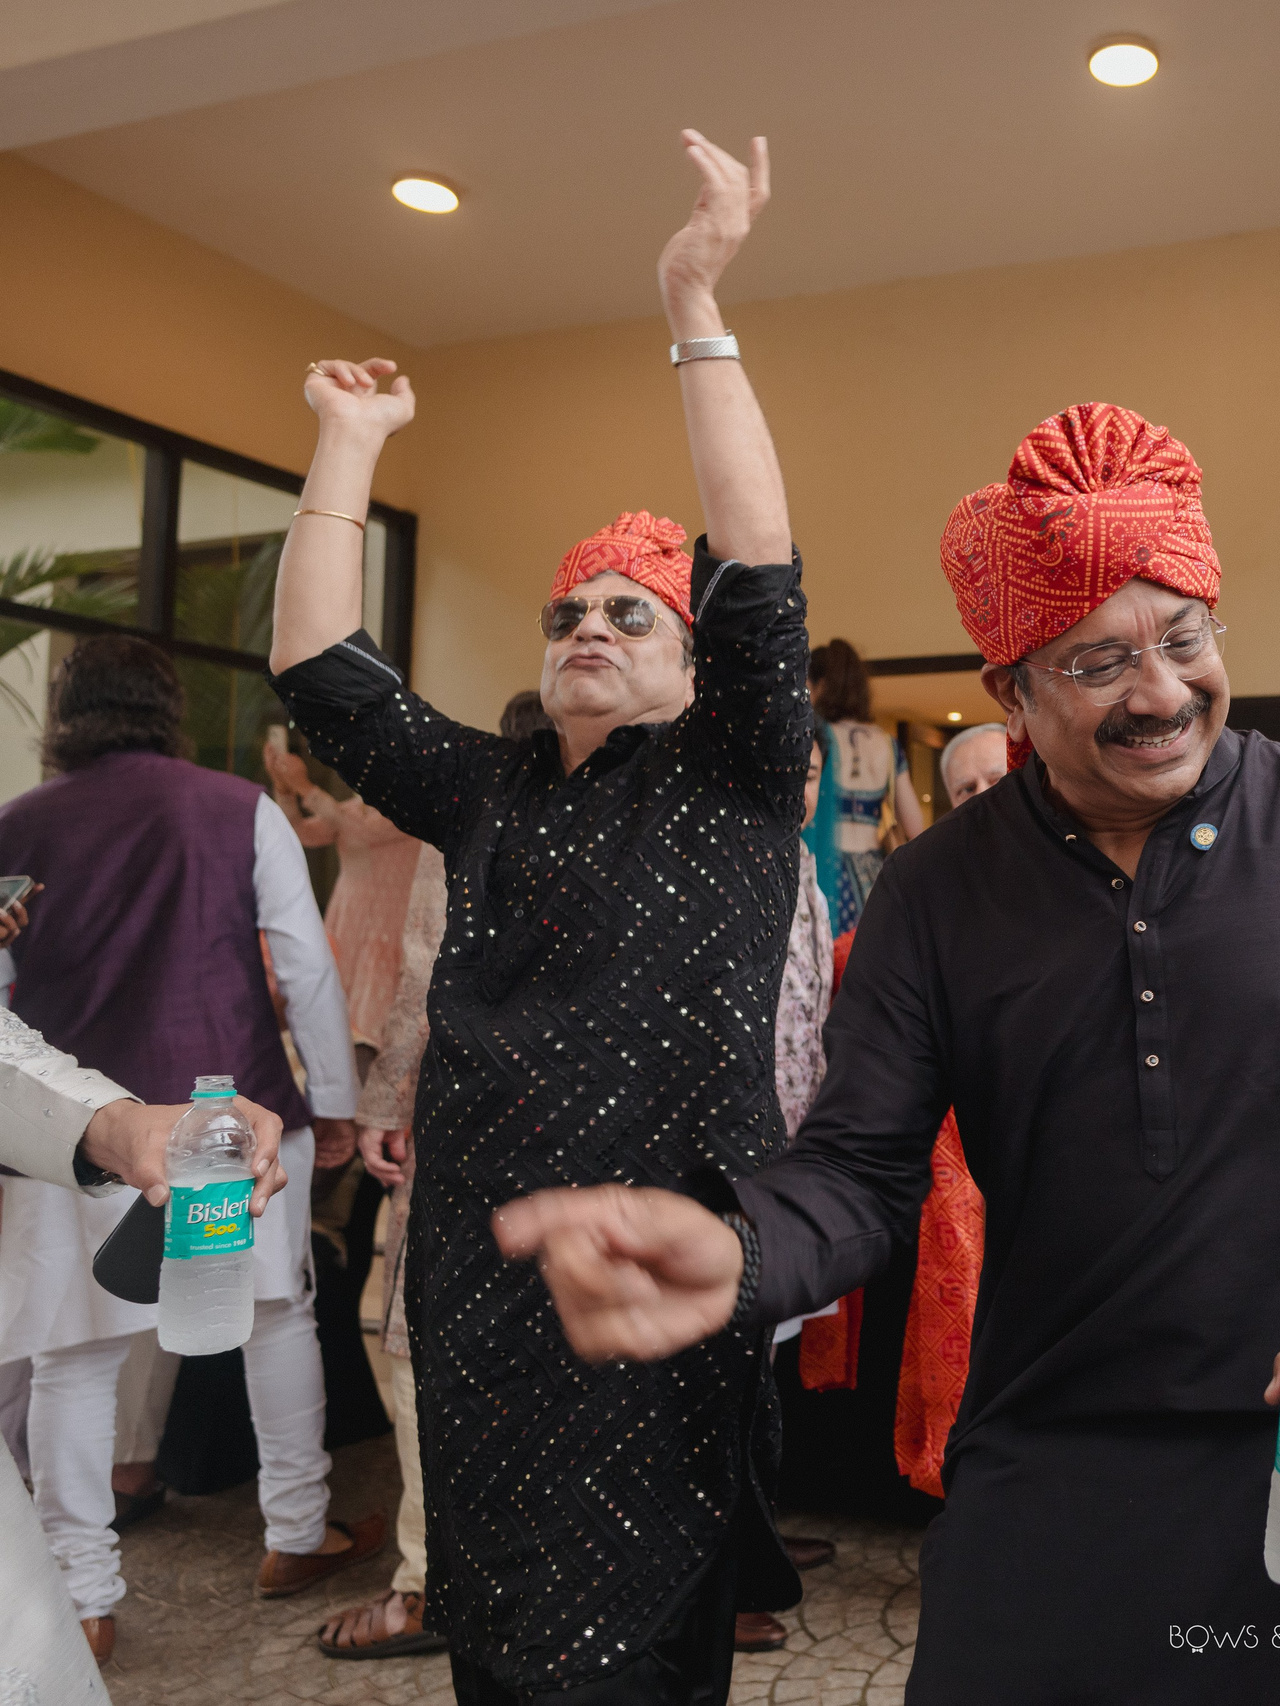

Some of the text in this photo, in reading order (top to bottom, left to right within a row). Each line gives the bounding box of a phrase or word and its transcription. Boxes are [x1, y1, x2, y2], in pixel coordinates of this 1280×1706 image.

[186, 1193, 249, 1225] Bisleri
[203, 1223, 237, 1238] 500
[189, 1243, 214, 1251] trusted
[214, 1242, 232, 1250] since
